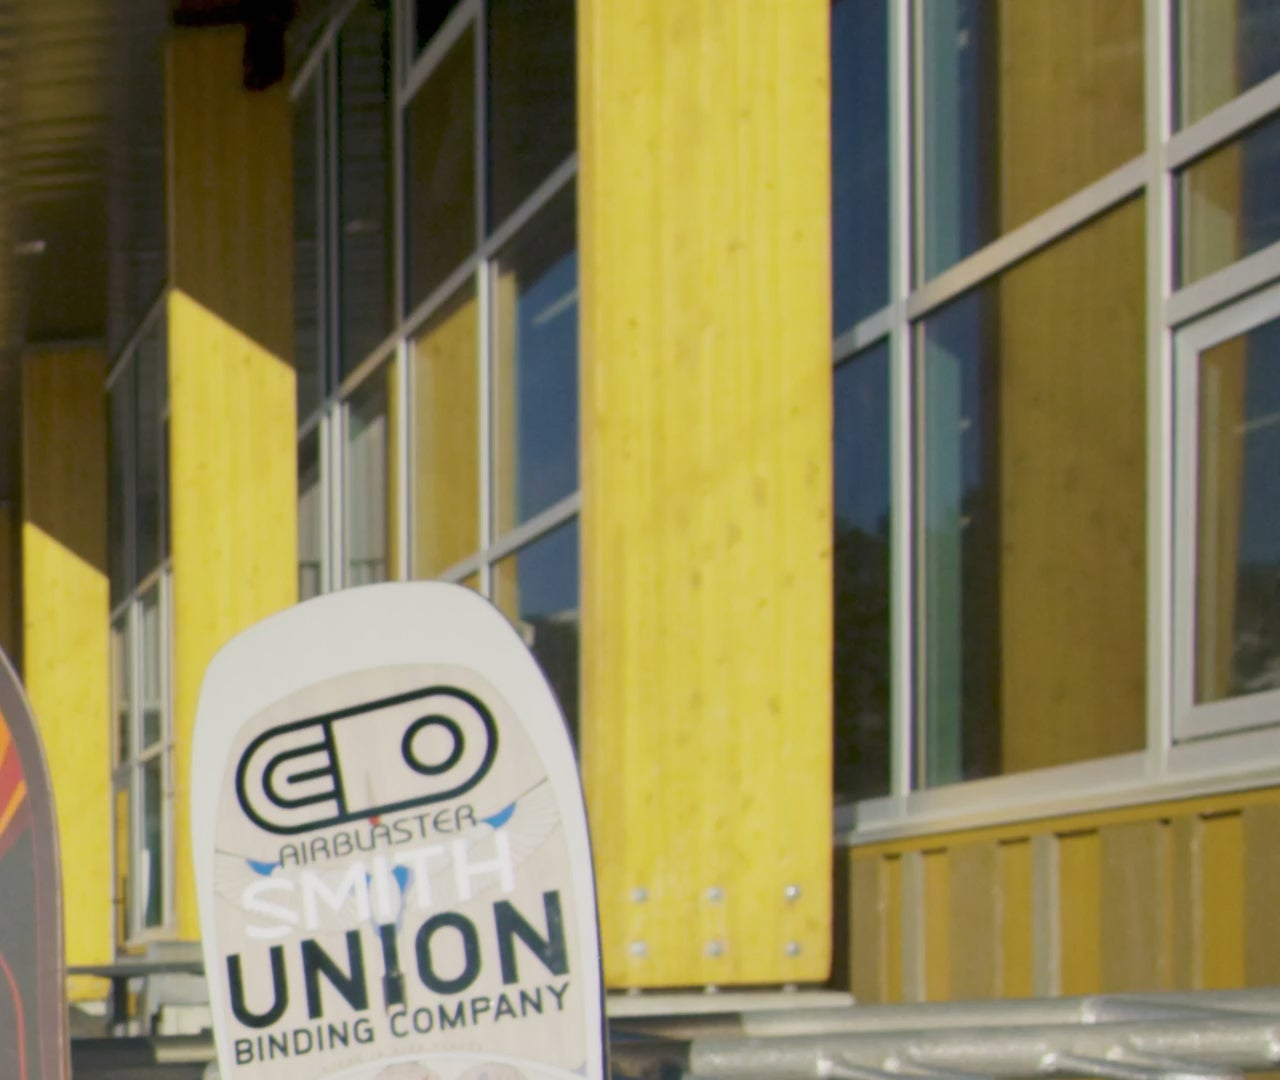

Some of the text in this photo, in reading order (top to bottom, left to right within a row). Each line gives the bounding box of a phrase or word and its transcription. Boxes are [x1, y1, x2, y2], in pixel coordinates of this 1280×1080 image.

[242, 828, 516, 939] SMITH
[278, 803, 478, 869] AIRBLASTER
[226, 890, 570, 1029] UNION
[235, 1018, 375, 1065] BINDING
[389, 982, 571, 1038] COMPANY
